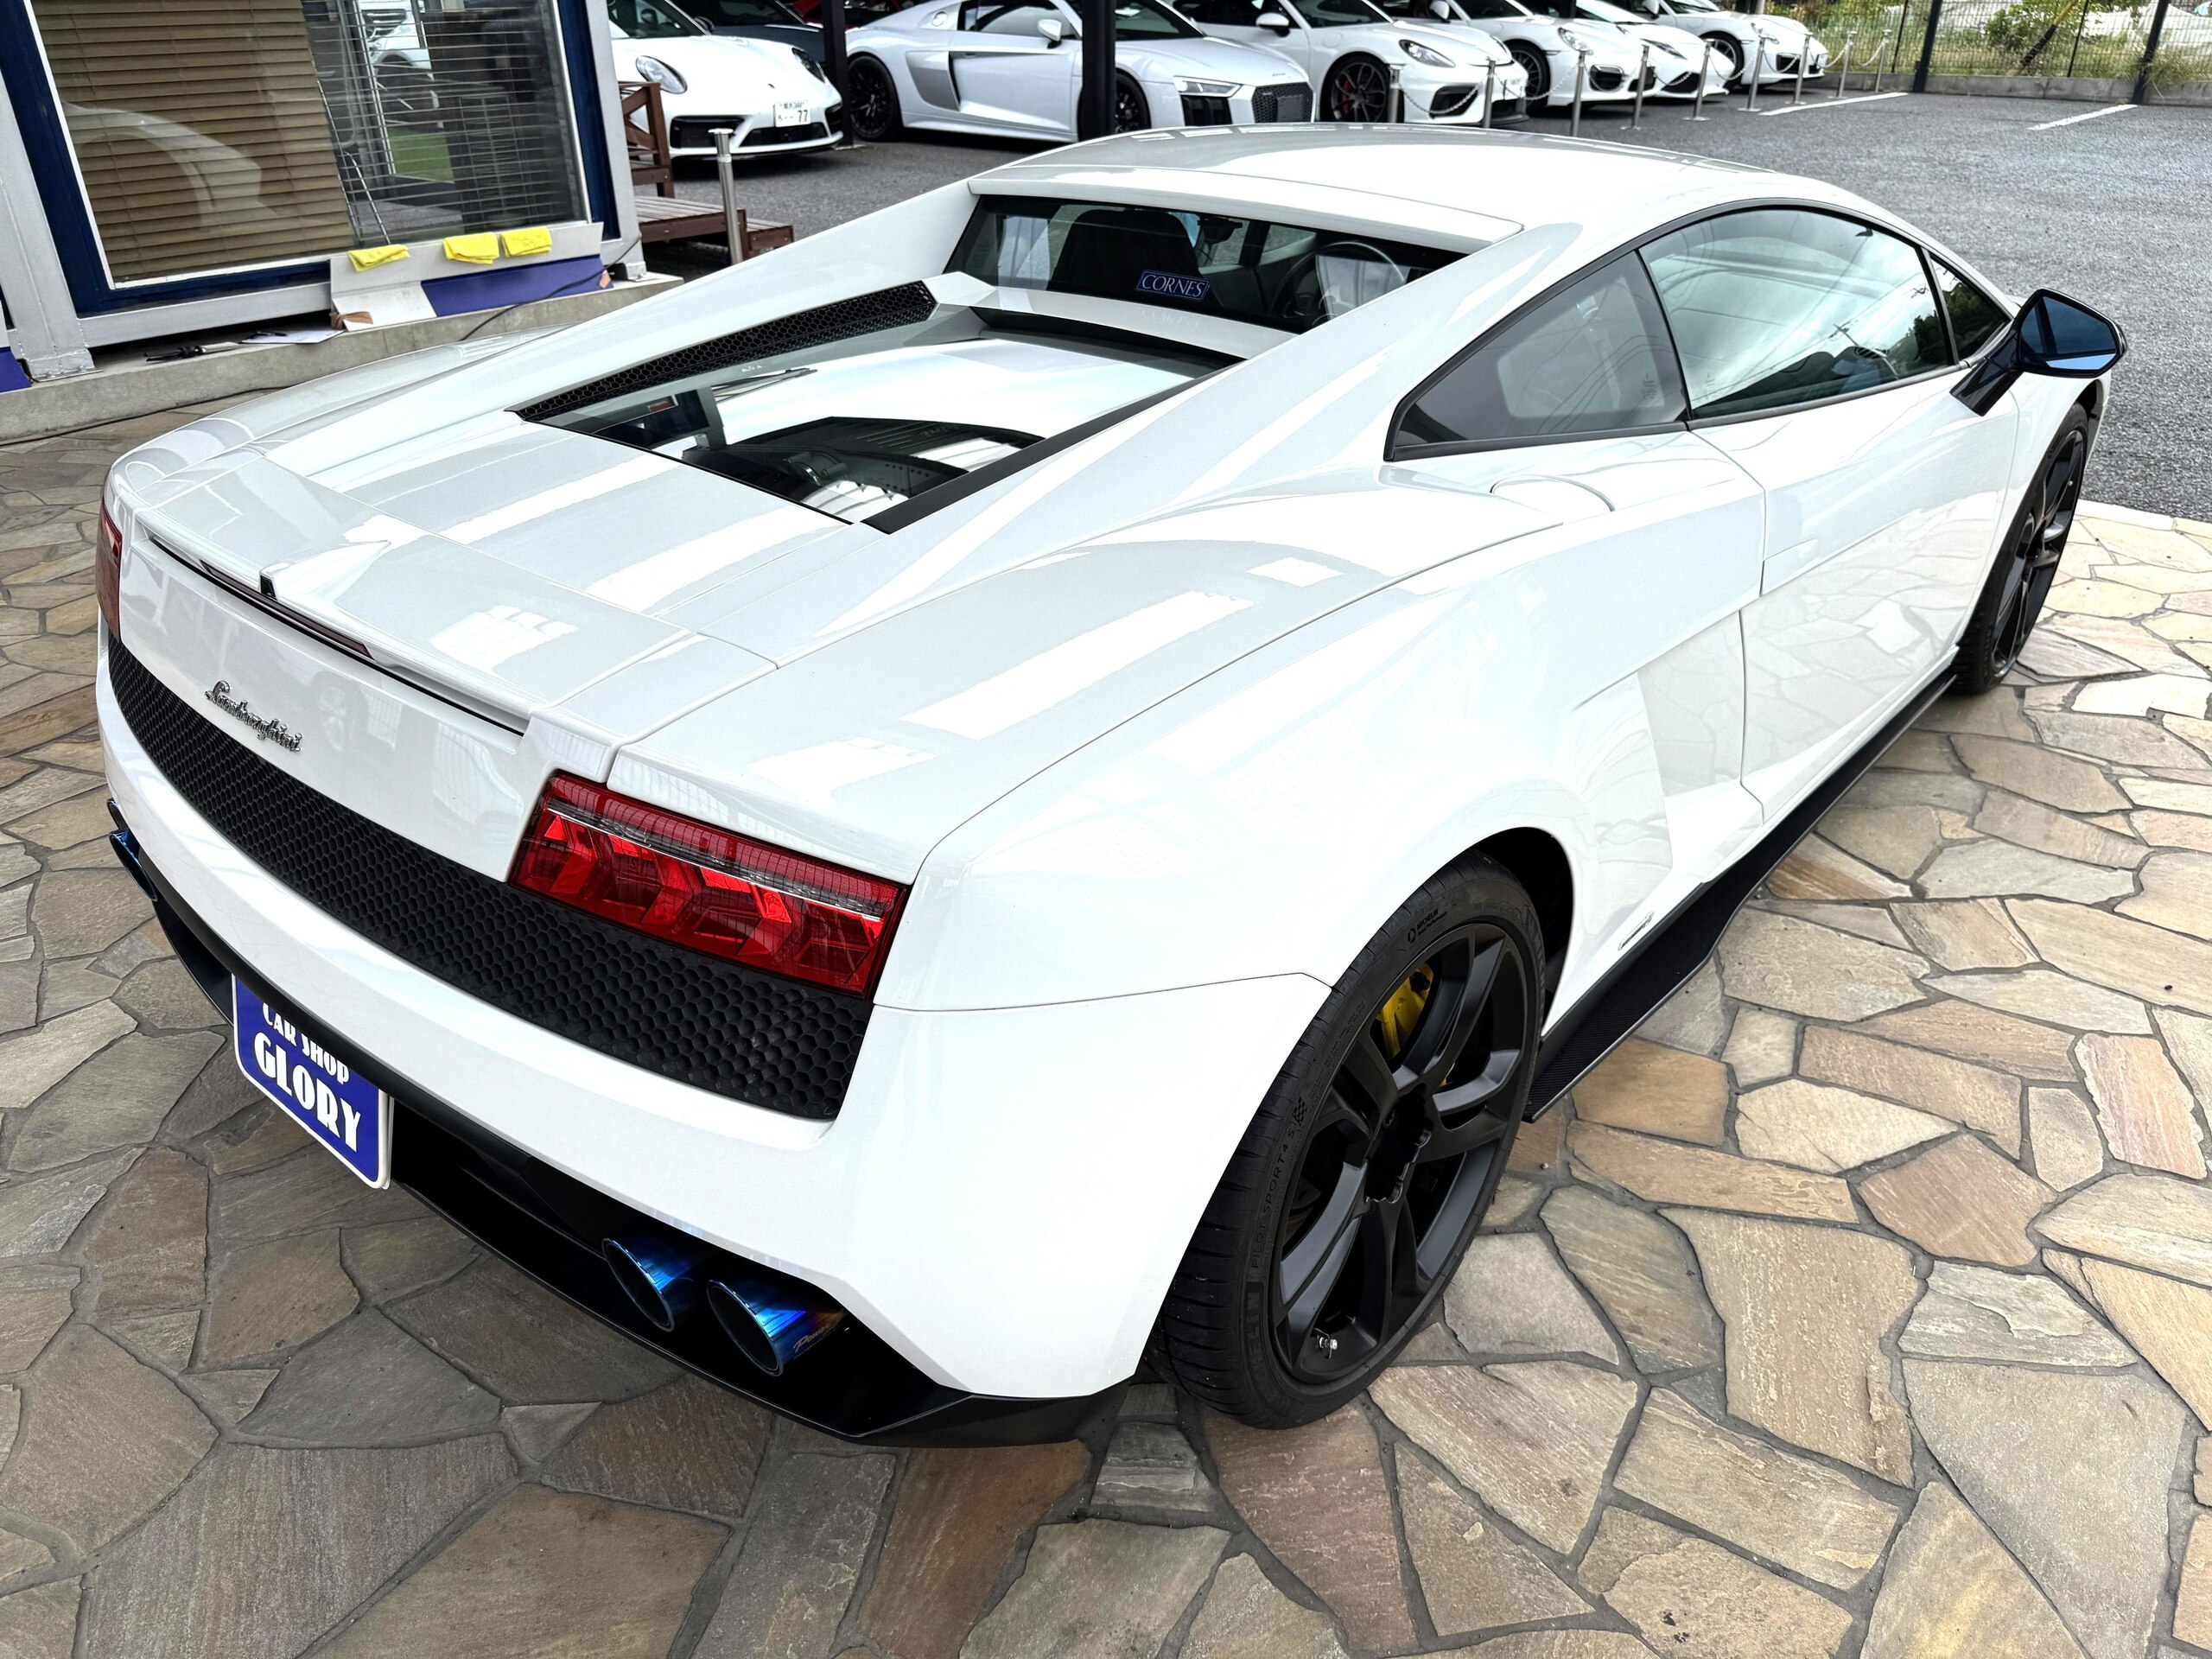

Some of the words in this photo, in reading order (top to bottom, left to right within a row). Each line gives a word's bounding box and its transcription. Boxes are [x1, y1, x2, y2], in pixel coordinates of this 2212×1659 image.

[798, 109, 808, 123] 77
[1142, 274, 1205, 297] CORNES
[204, 680, 302, 752] Lamborghini
[263, 1002, 297, 1047] CAR
[301, 1033, 349, 1085] SHOP
[254, 1032, 360, 1153] GLORY
[1251, 1222, 1266, 1268] PILOT
[1262, 1155, 1285, 1213] SPORT
